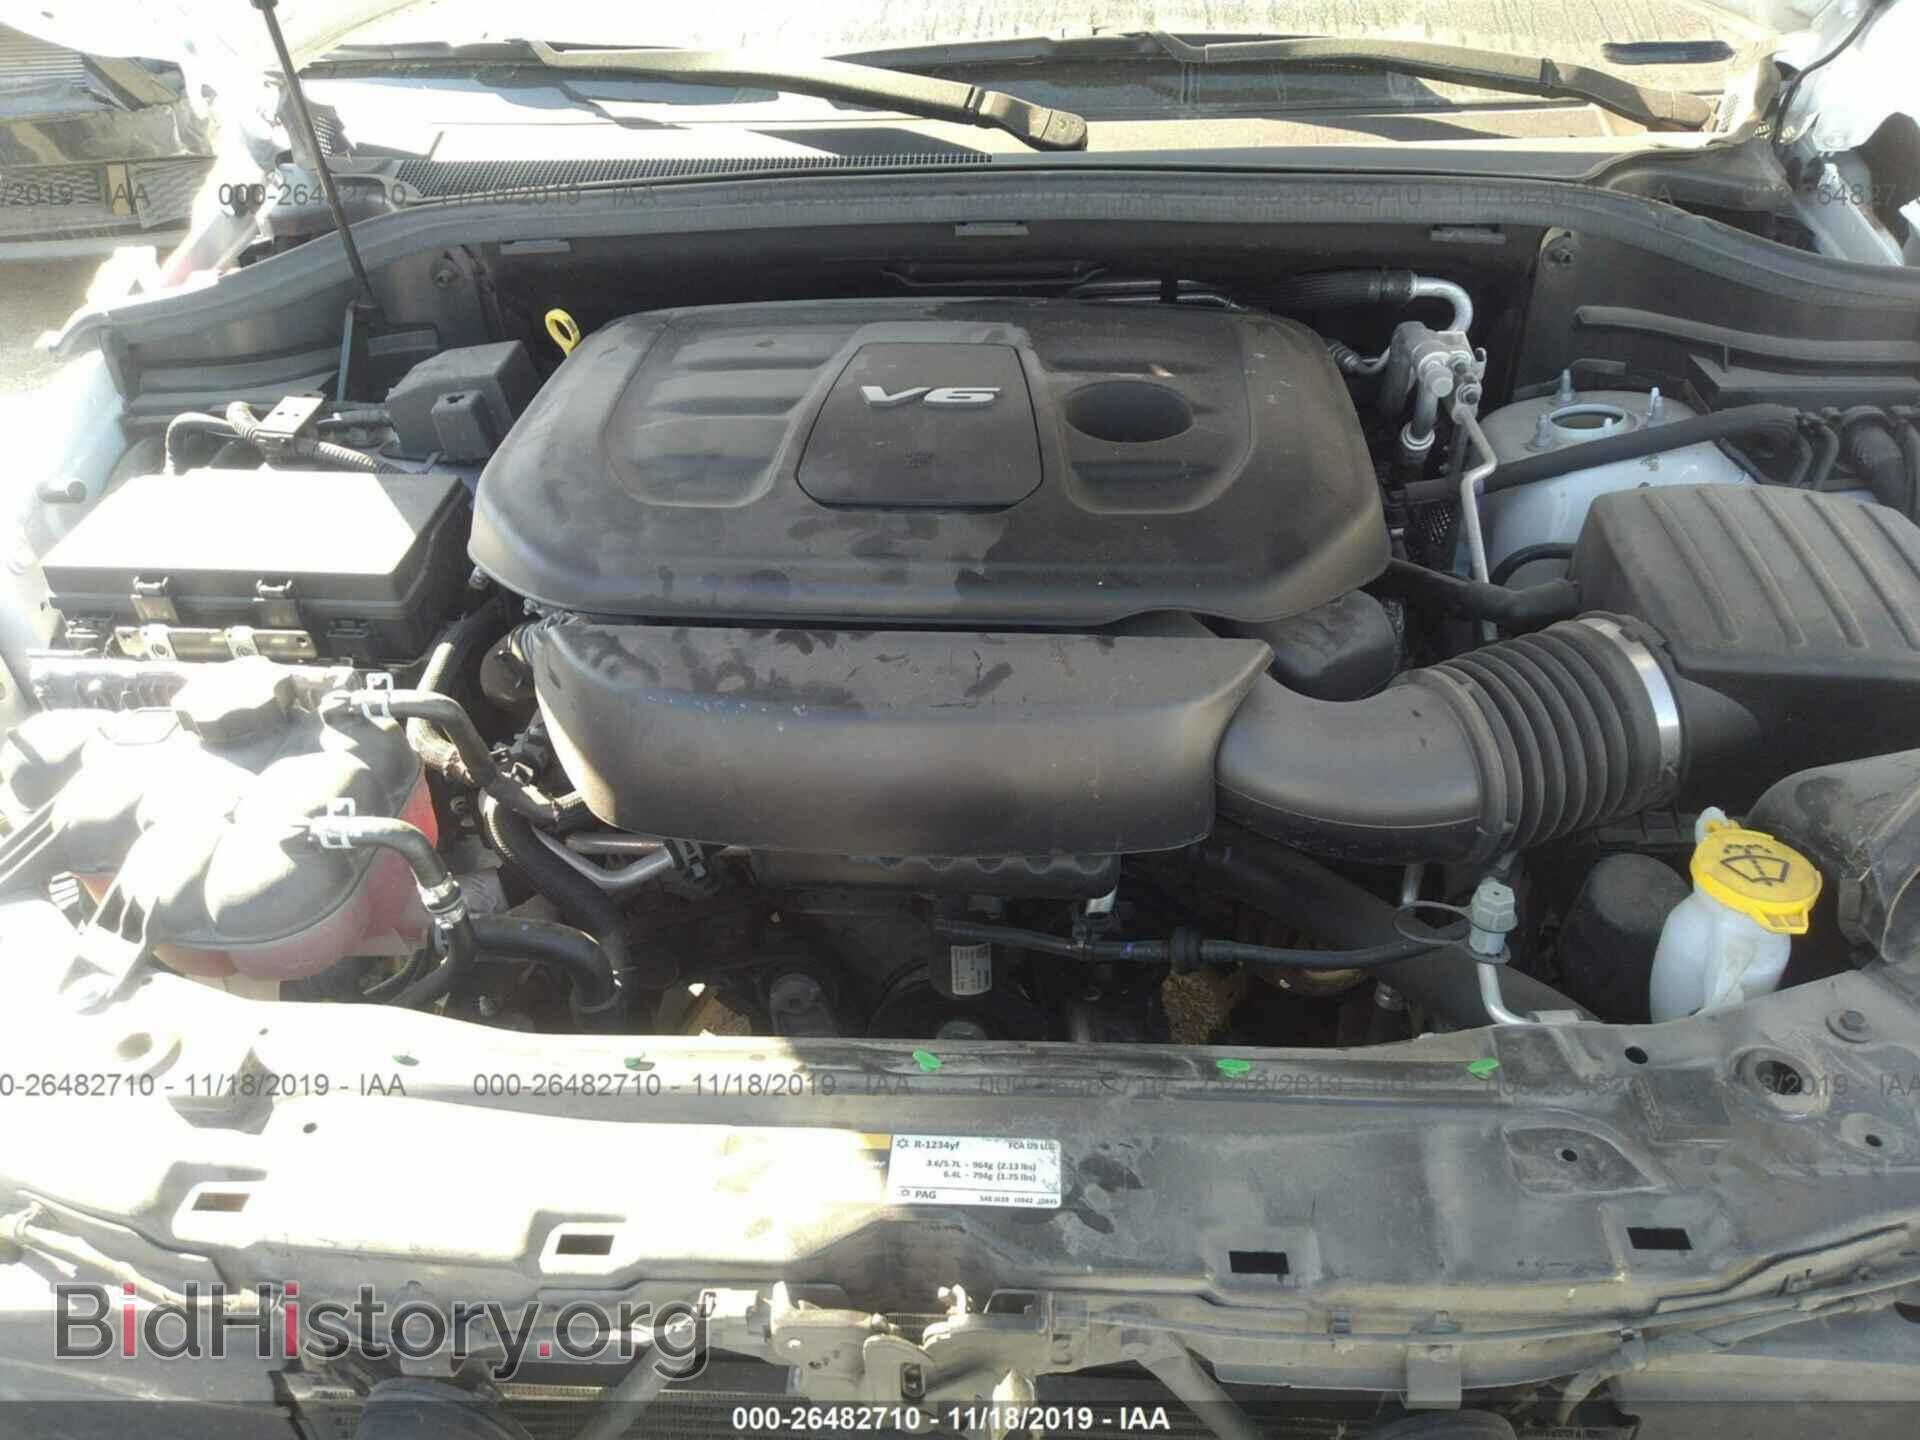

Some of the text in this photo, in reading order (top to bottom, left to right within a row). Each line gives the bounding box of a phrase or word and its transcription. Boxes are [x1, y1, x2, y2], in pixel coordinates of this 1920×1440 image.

[861, 385, 1001, 407] V6
[914, 1141, 960, 1151] R-1234yf
[915, 1190, 937, 1199] PAG
